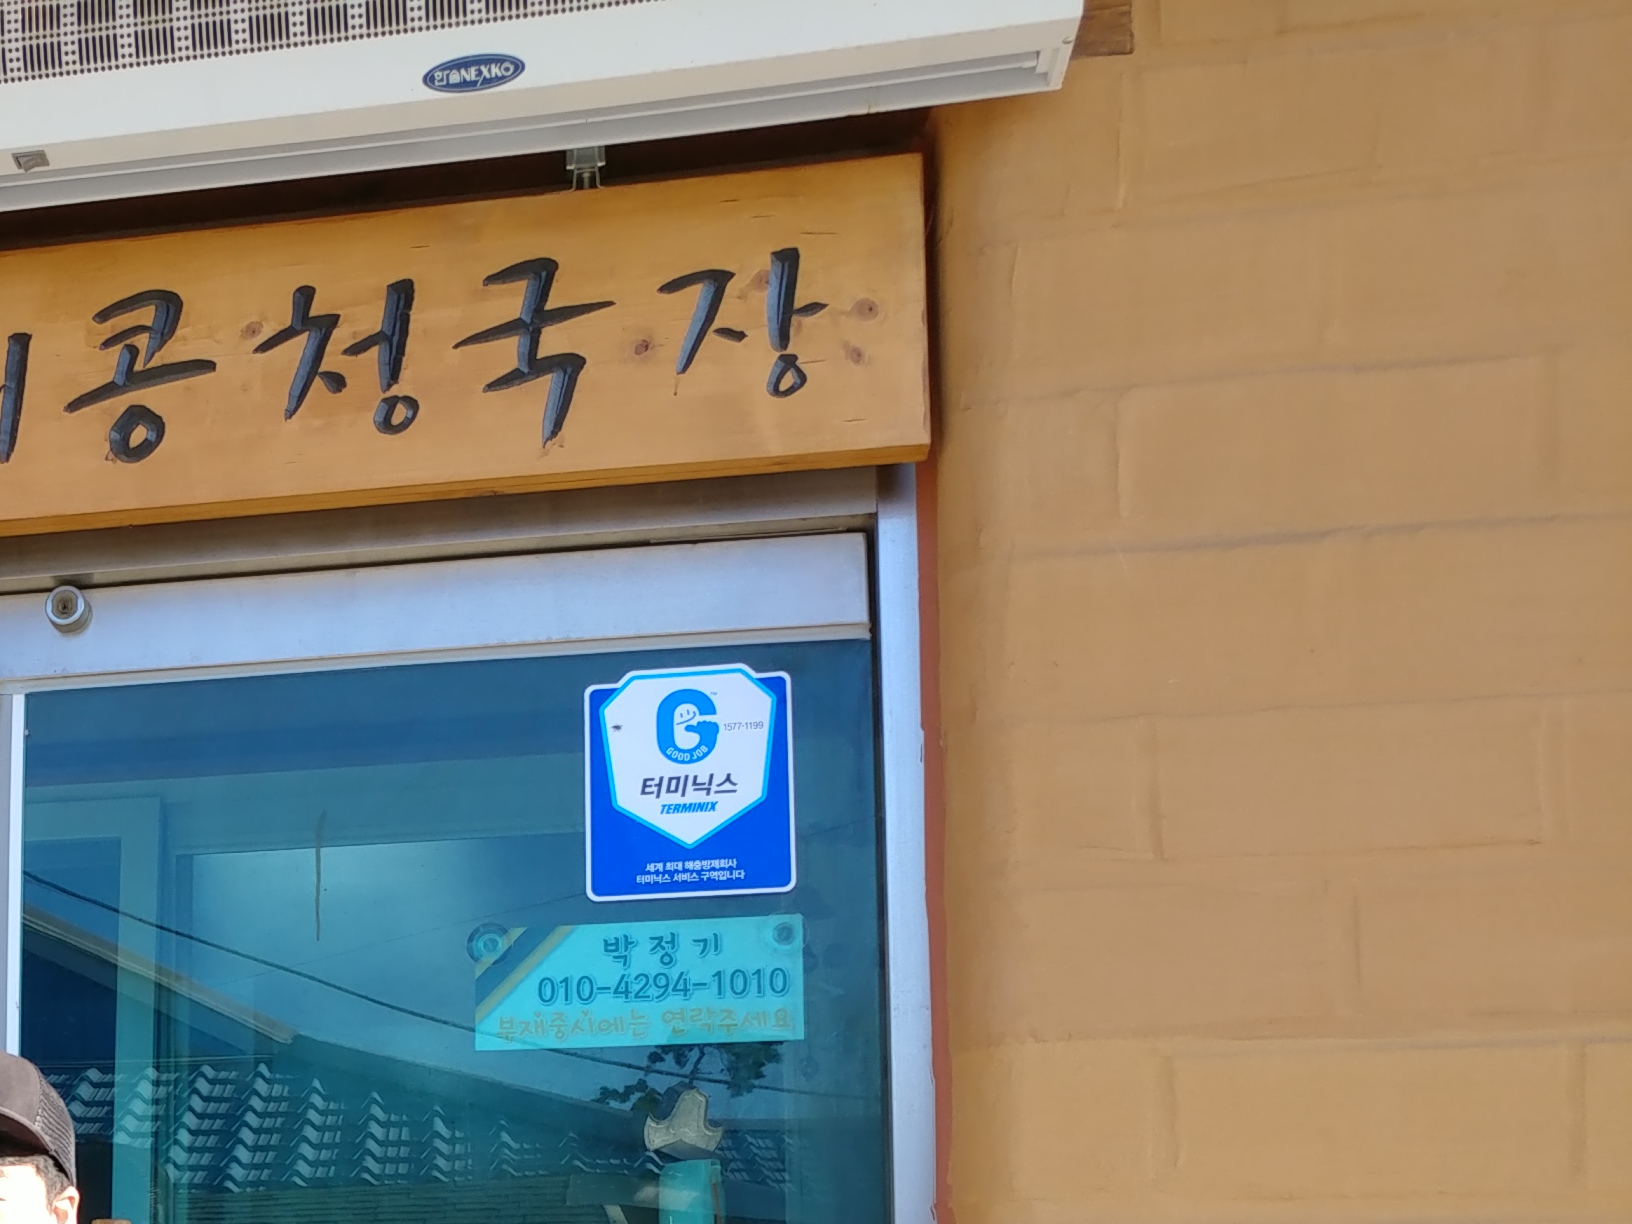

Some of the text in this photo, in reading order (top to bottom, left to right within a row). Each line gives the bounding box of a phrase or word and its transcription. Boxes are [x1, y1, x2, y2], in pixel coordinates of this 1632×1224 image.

[723, 721, 764, 732] 1577-1199
[665, 745, 709, 762] GOOD JOB
[639, 773, 739, 799] 터미닉스
[659, 801, 719, 815] TERMINIX
[645, 859, 738, 873] 세계 최대 해충방제회사
[636, 870, 746, 884] 터미닉스 서비스 구역입니다
[537, 966, 789, 1005] 010-4294-1010
[661, 1006, 793, 1036] 연락주세요
